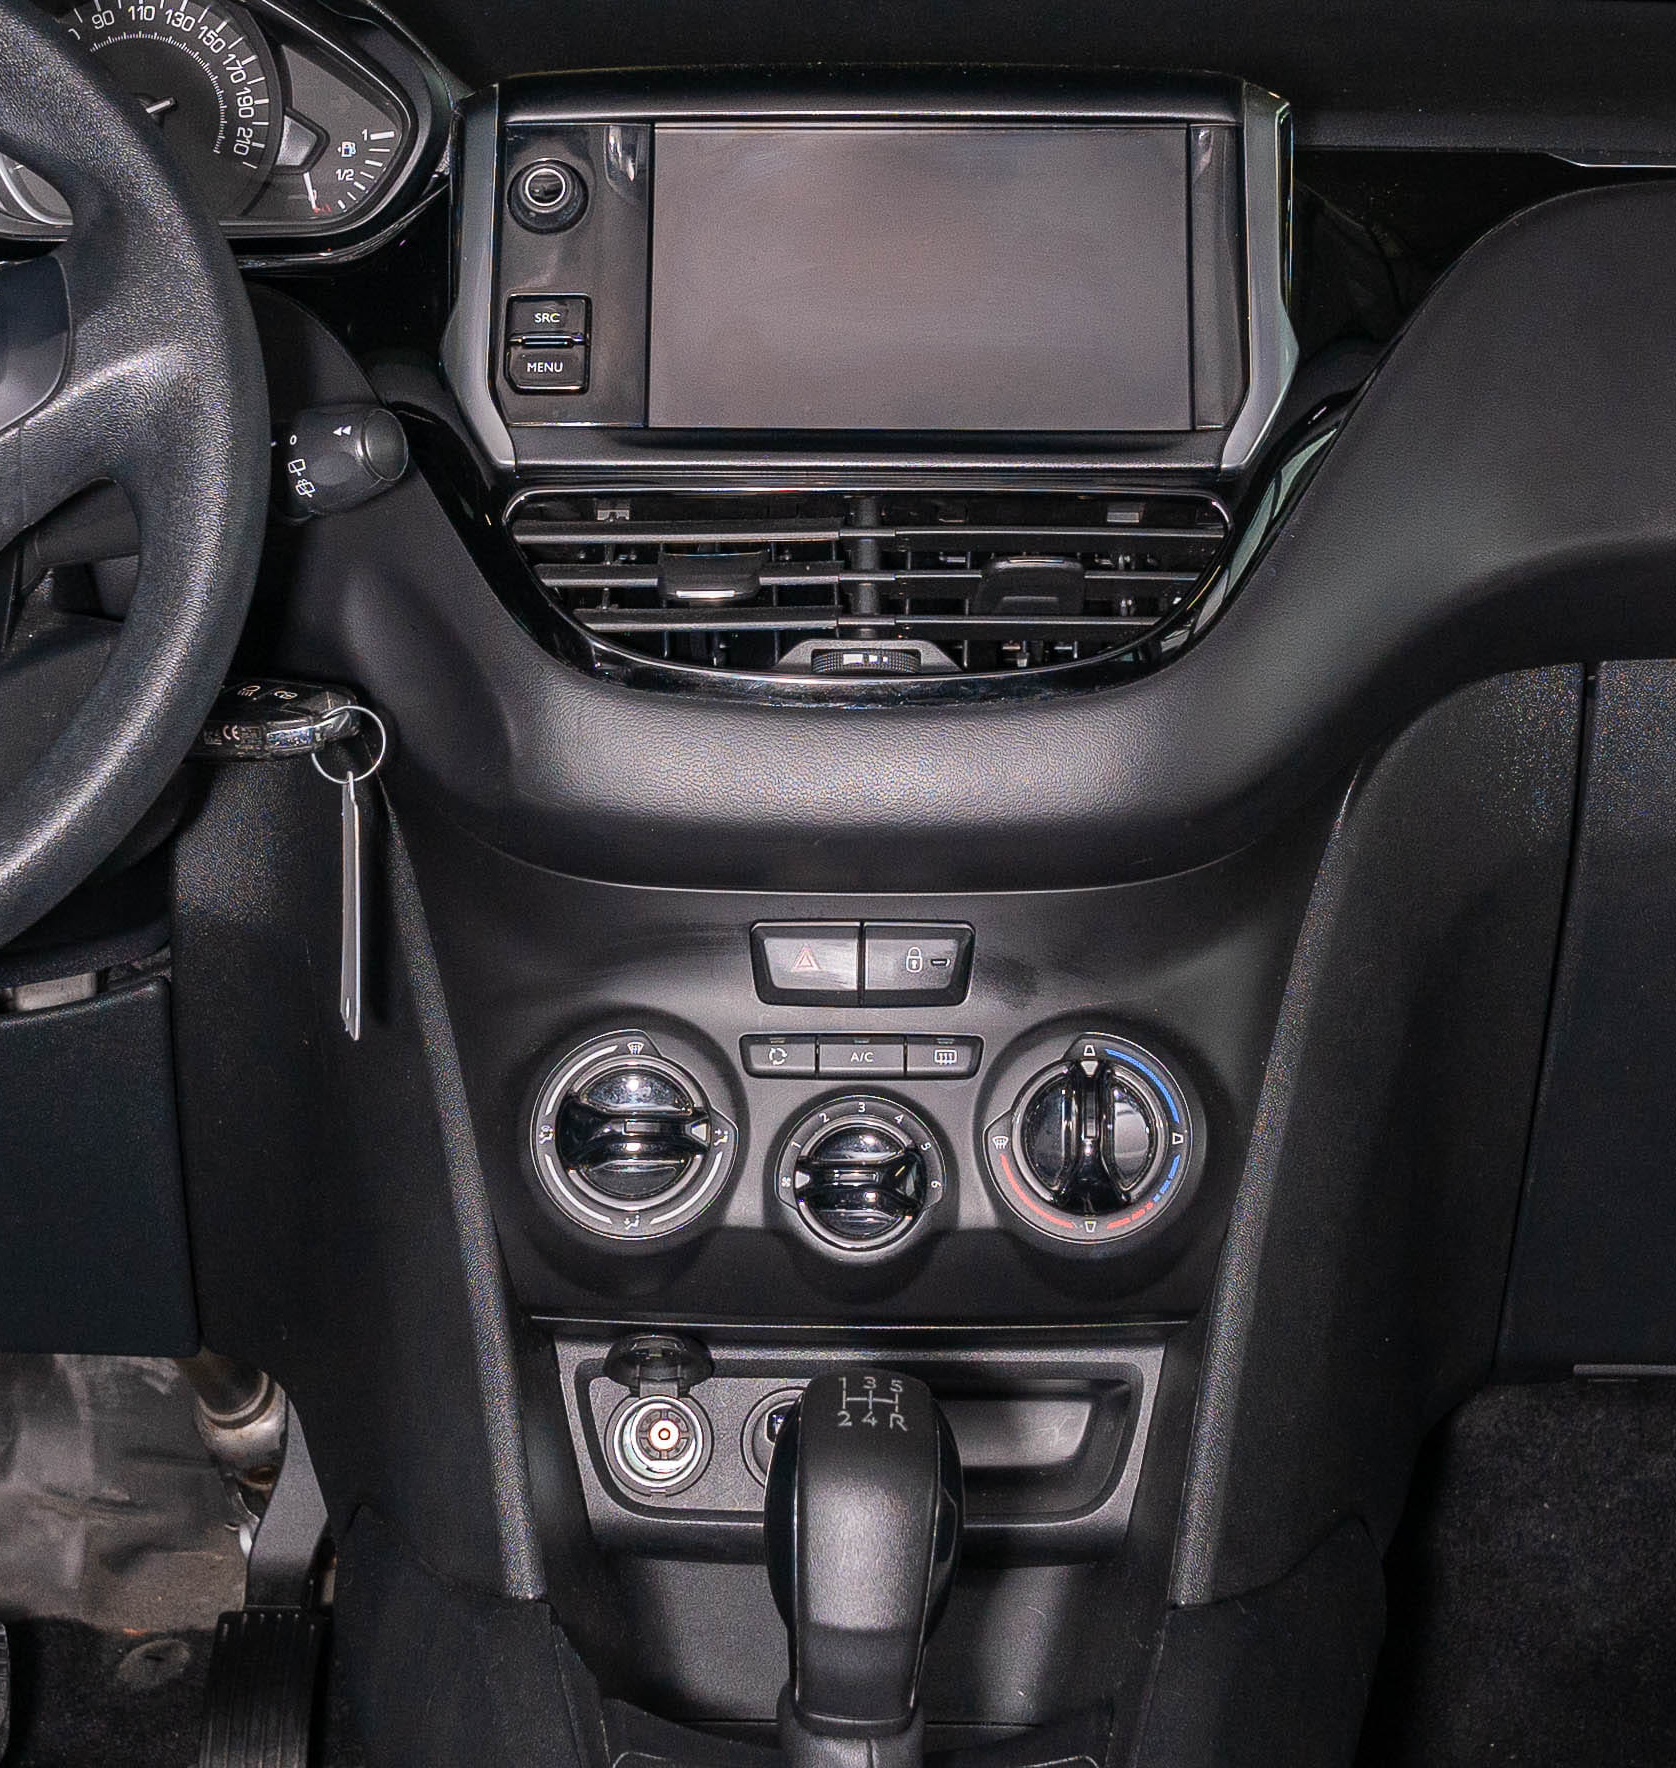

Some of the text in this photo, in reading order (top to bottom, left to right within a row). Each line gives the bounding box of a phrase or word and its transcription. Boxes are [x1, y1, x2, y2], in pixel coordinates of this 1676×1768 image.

[91, 10, 115, 30] 90
[128, 6, 156, 21] 110
[165, 8, 197, 32] 130
[196, 25, 227, 54] 150
[223, 53, 248, 84] 170
[234, 87, 255, 119] 190
[233, 126, 254, 157] 210
[361, 128, 368, 142] 1
[335, 168, 356, 182] 1/2
[534, 312, 562, 324] SRC
[526, 361, 563, 373] MENU
[850, 1052, 875, 1063] A/C
[858, 1102, 866, 1113] 3
[818, 1112, 831, 1124] 2
[894, 1114, 905, 1124] 4
[791, 1141, 802, 1149] 1
[920, 1141, 932, 1152] 5
[931, 1180, 942, 1189] 6
[863, 1376, 877, 1390] 3
[889, 1379, 903, 1393] 5
[837, 1410, 907, 1432] 2 4 R
